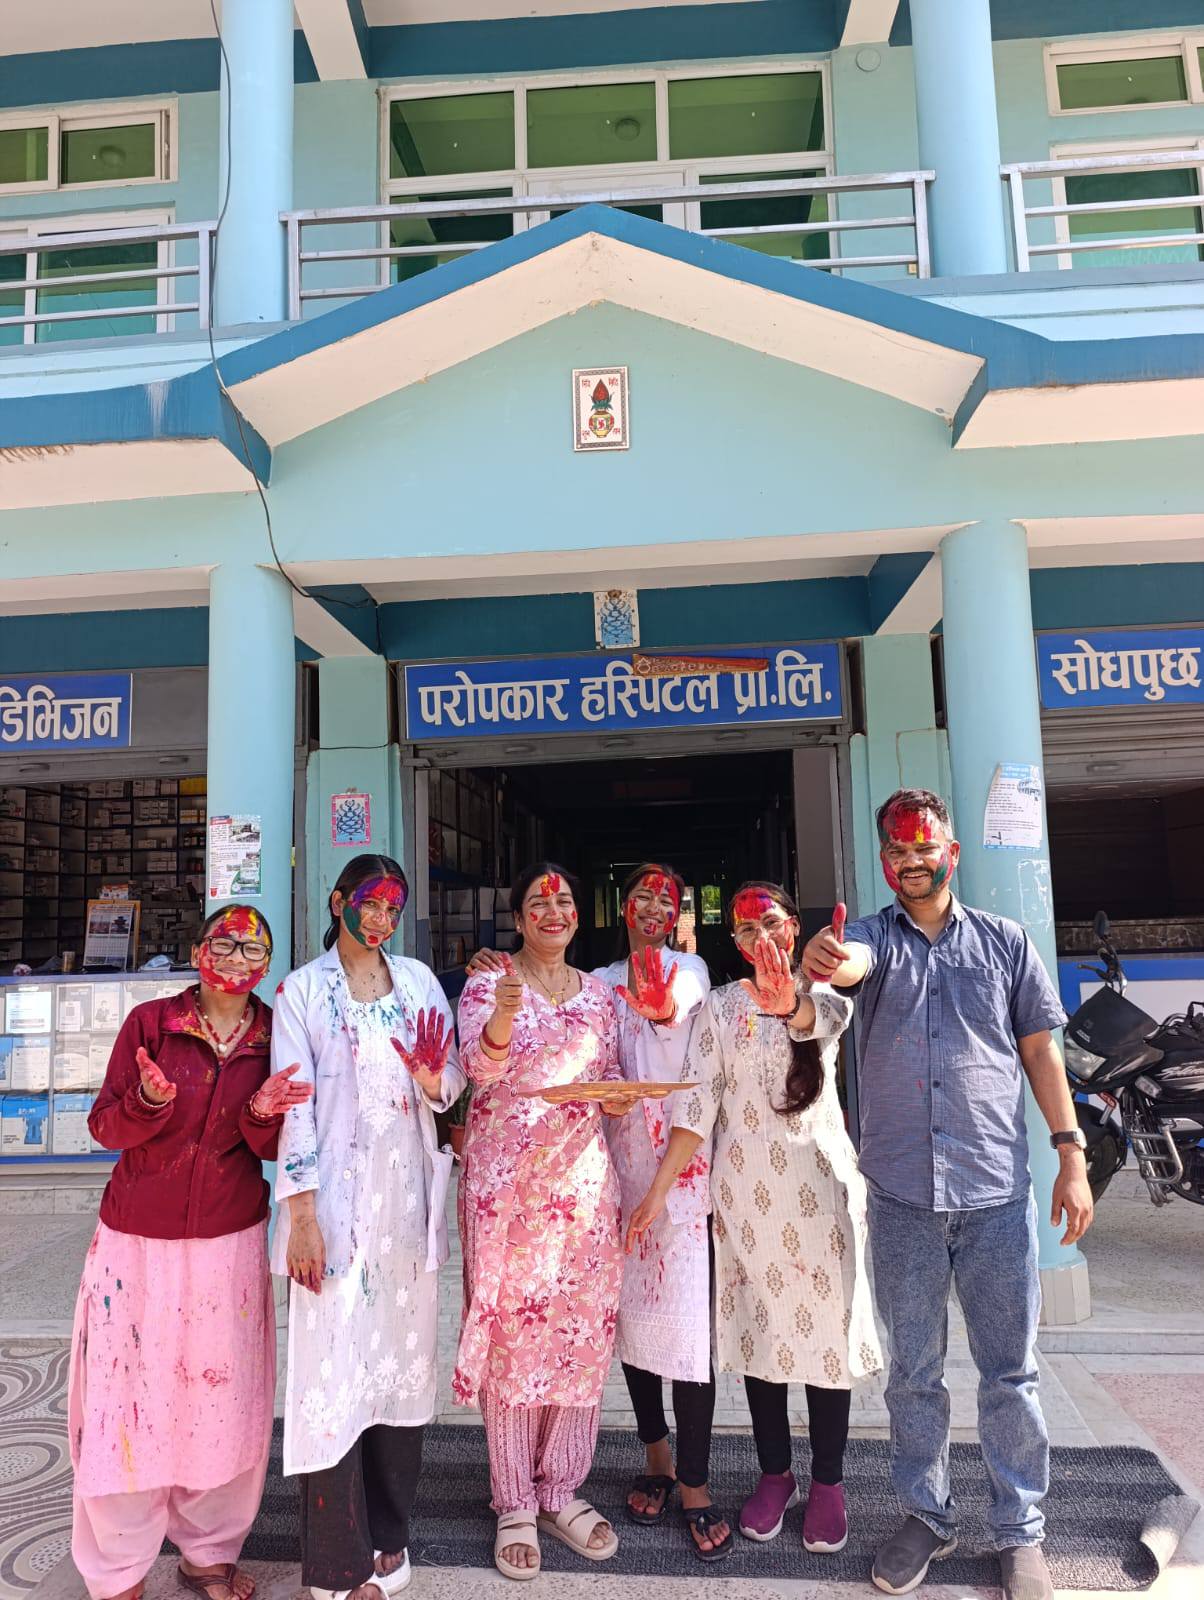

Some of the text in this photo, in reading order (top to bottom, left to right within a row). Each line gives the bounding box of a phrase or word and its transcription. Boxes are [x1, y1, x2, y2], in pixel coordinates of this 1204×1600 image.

[418, 649, 832, 727] परोपकार हस्पिटल प्रा.लि.
[1050, 639, 1202, 701] सोधपुछ
